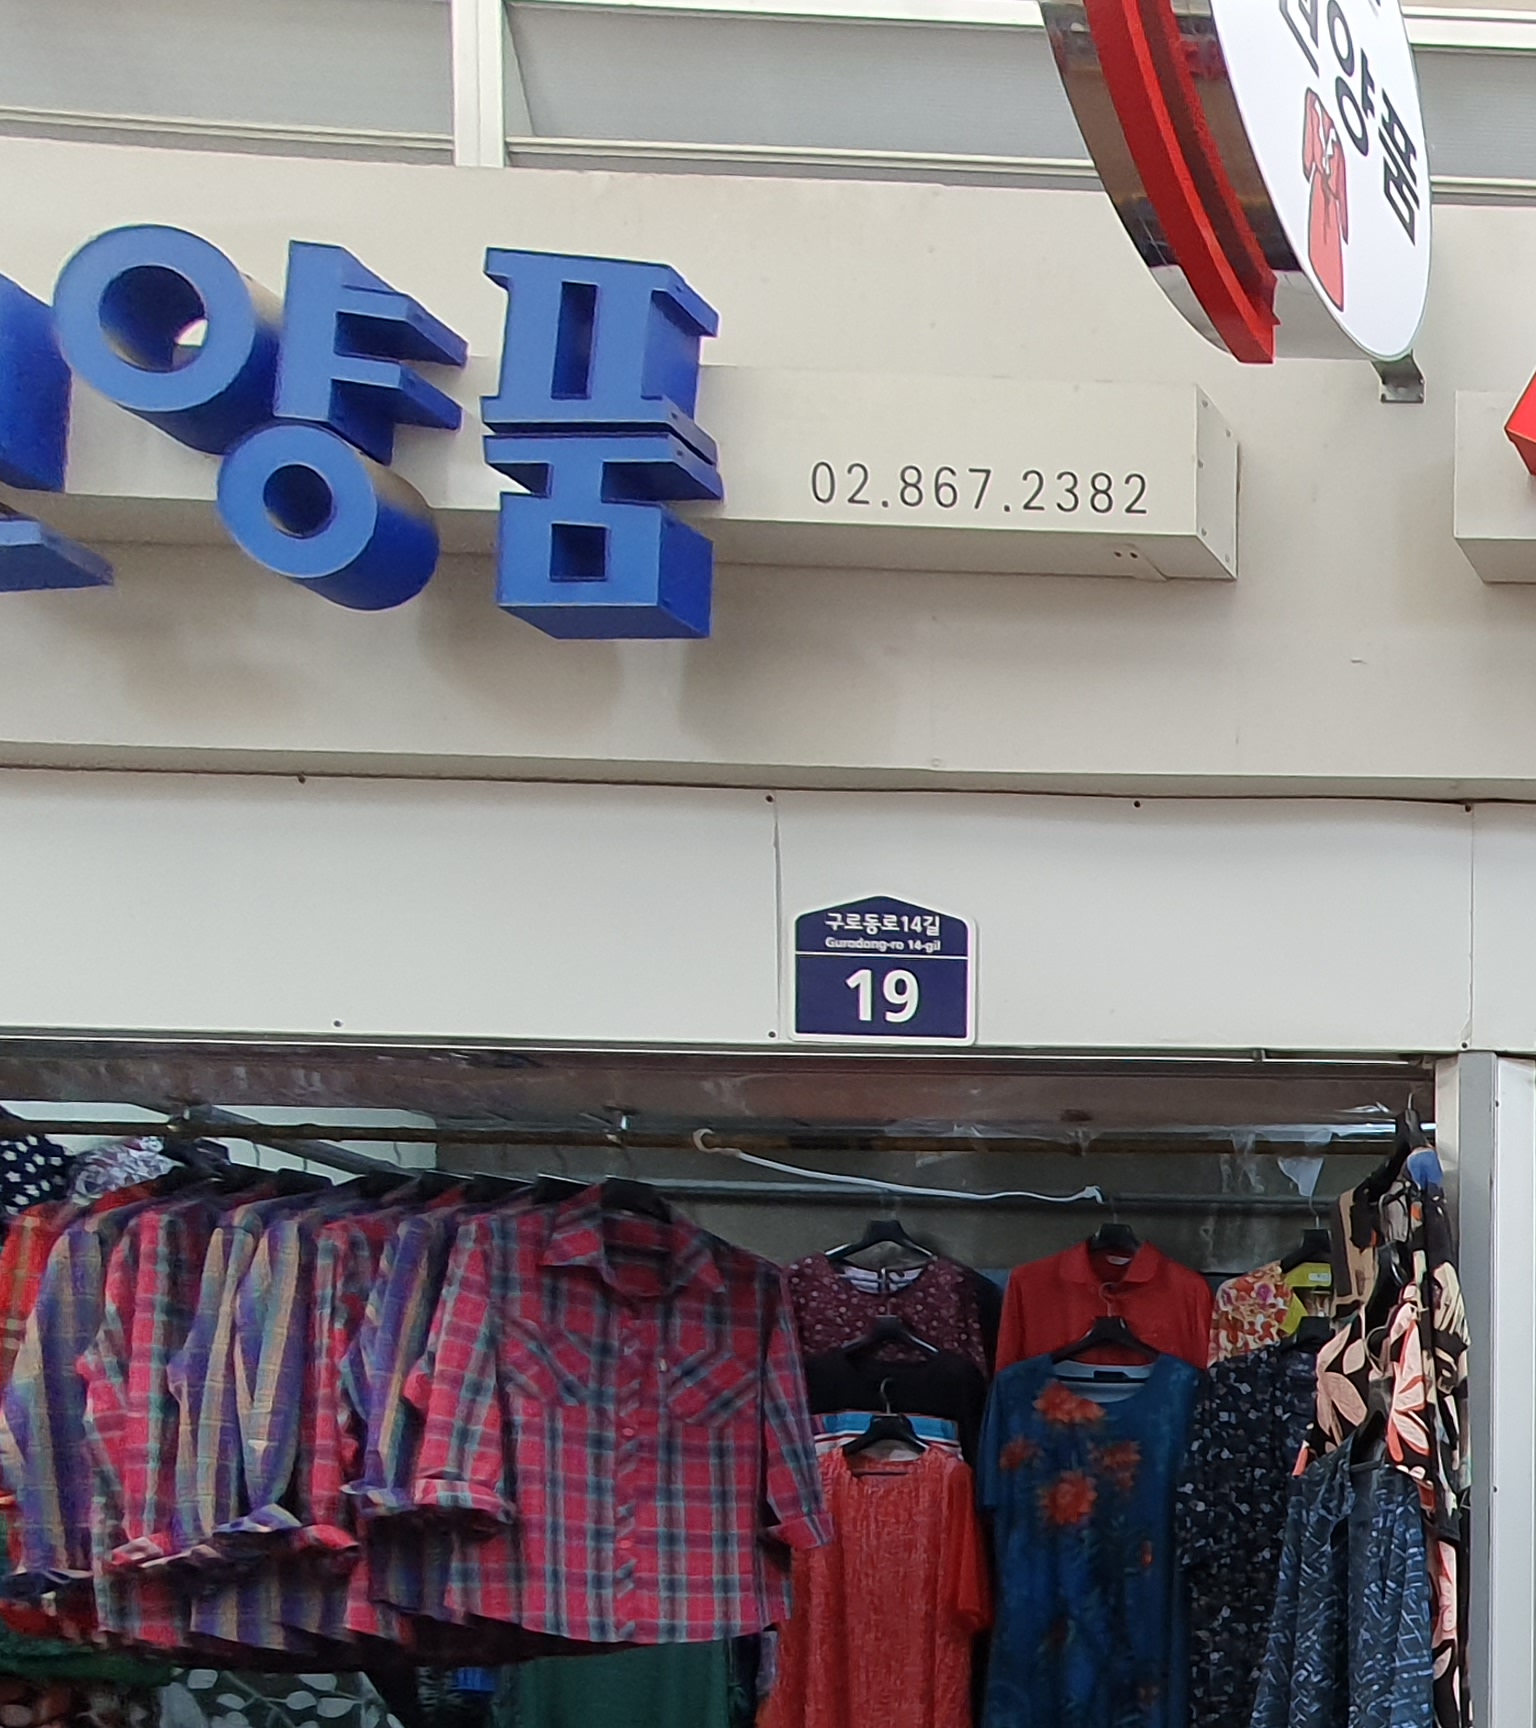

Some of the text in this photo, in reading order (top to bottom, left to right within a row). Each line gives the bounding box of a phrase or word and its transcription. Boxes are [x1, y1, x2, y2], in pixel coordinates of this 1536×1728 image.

[0, 224, 725, 640] 양품
[809, 459, 1149, 518] 02.867.2382
[824, 912, 941, 936] 구로동로14길
[845, 968, 919, 1023] 19
